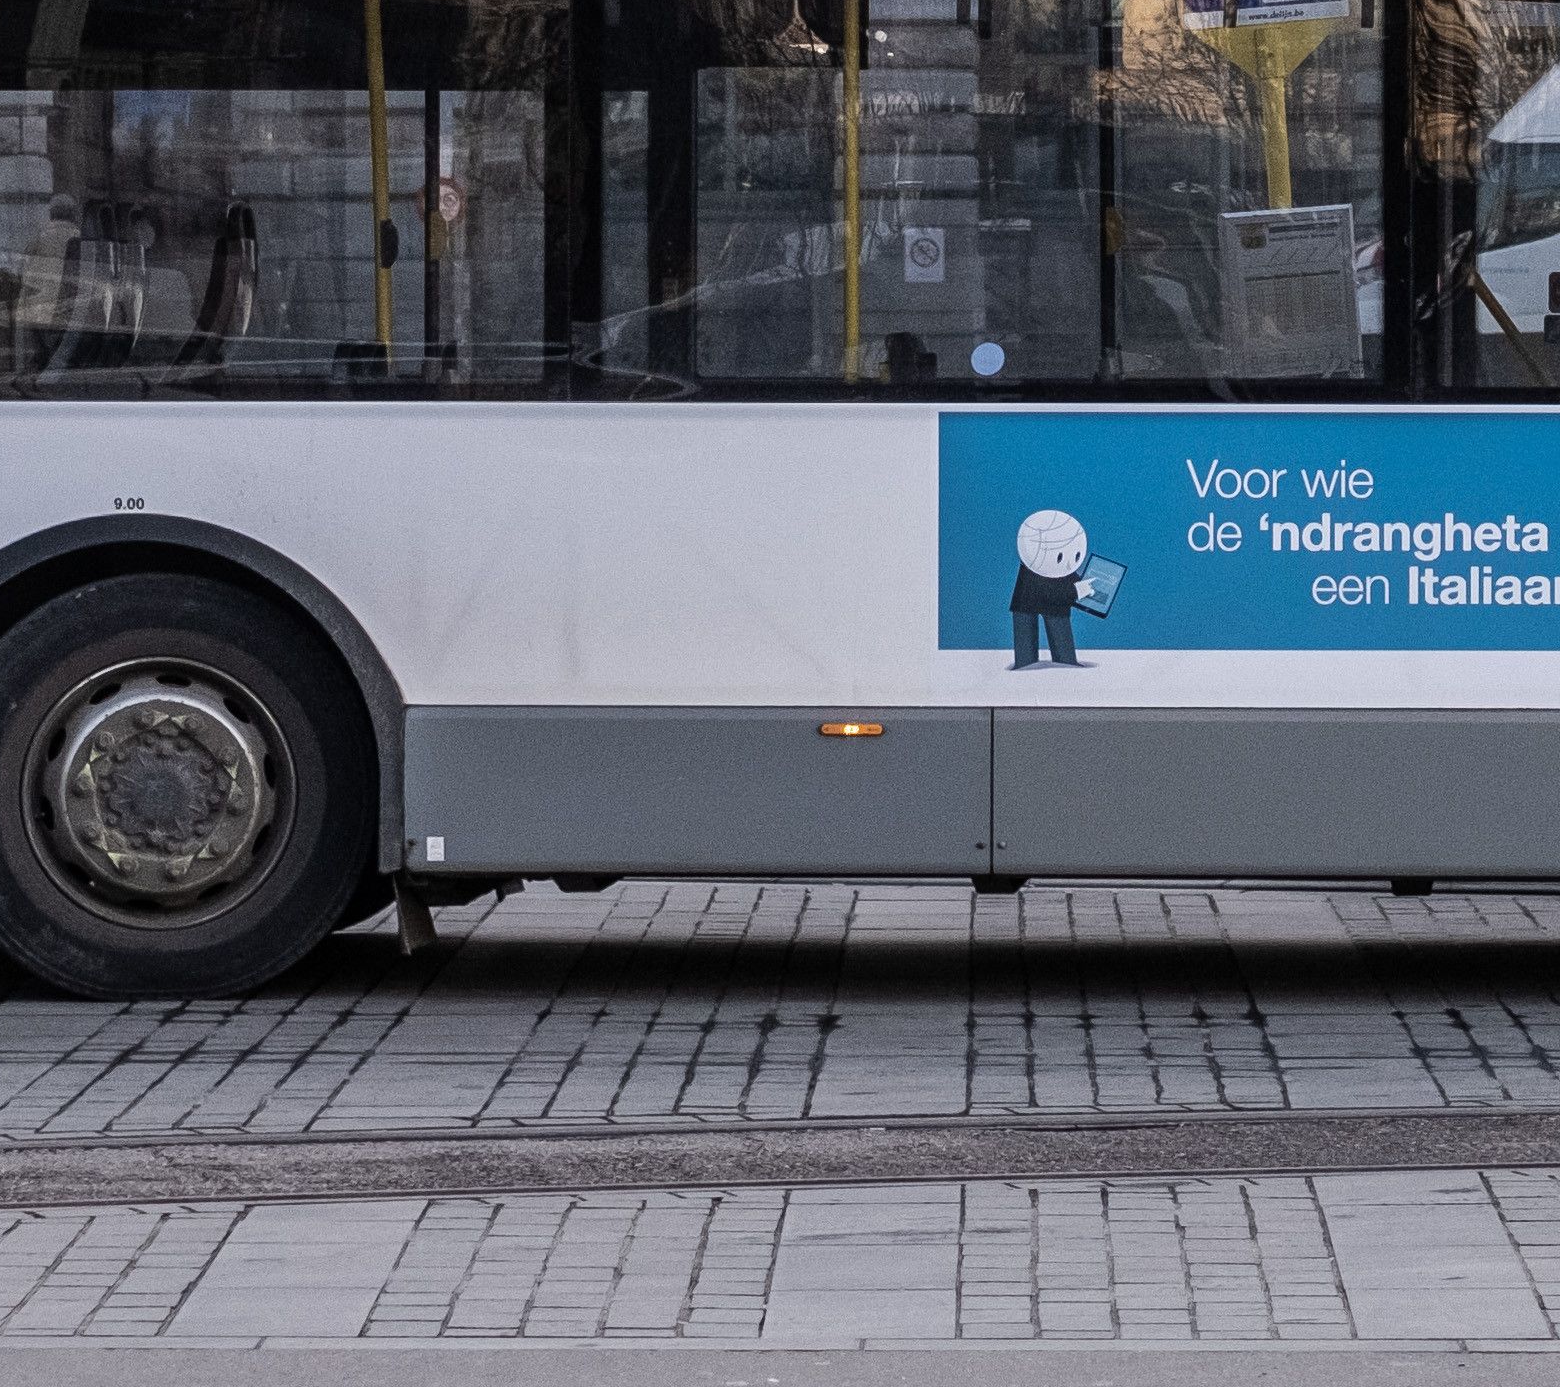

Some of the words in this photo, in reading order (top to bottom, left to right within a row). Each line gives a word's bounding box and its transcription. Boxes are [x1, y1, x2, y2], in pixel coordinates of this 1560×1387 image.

[1186, 458, 1288, 500] Voor
[1301, 459, 1374, 500] wie
[1187, 513, 1242, 553] de
[1259, 512, 1549, 562] ‘ndrangheta
[1311, 574, 1390, 606] een
